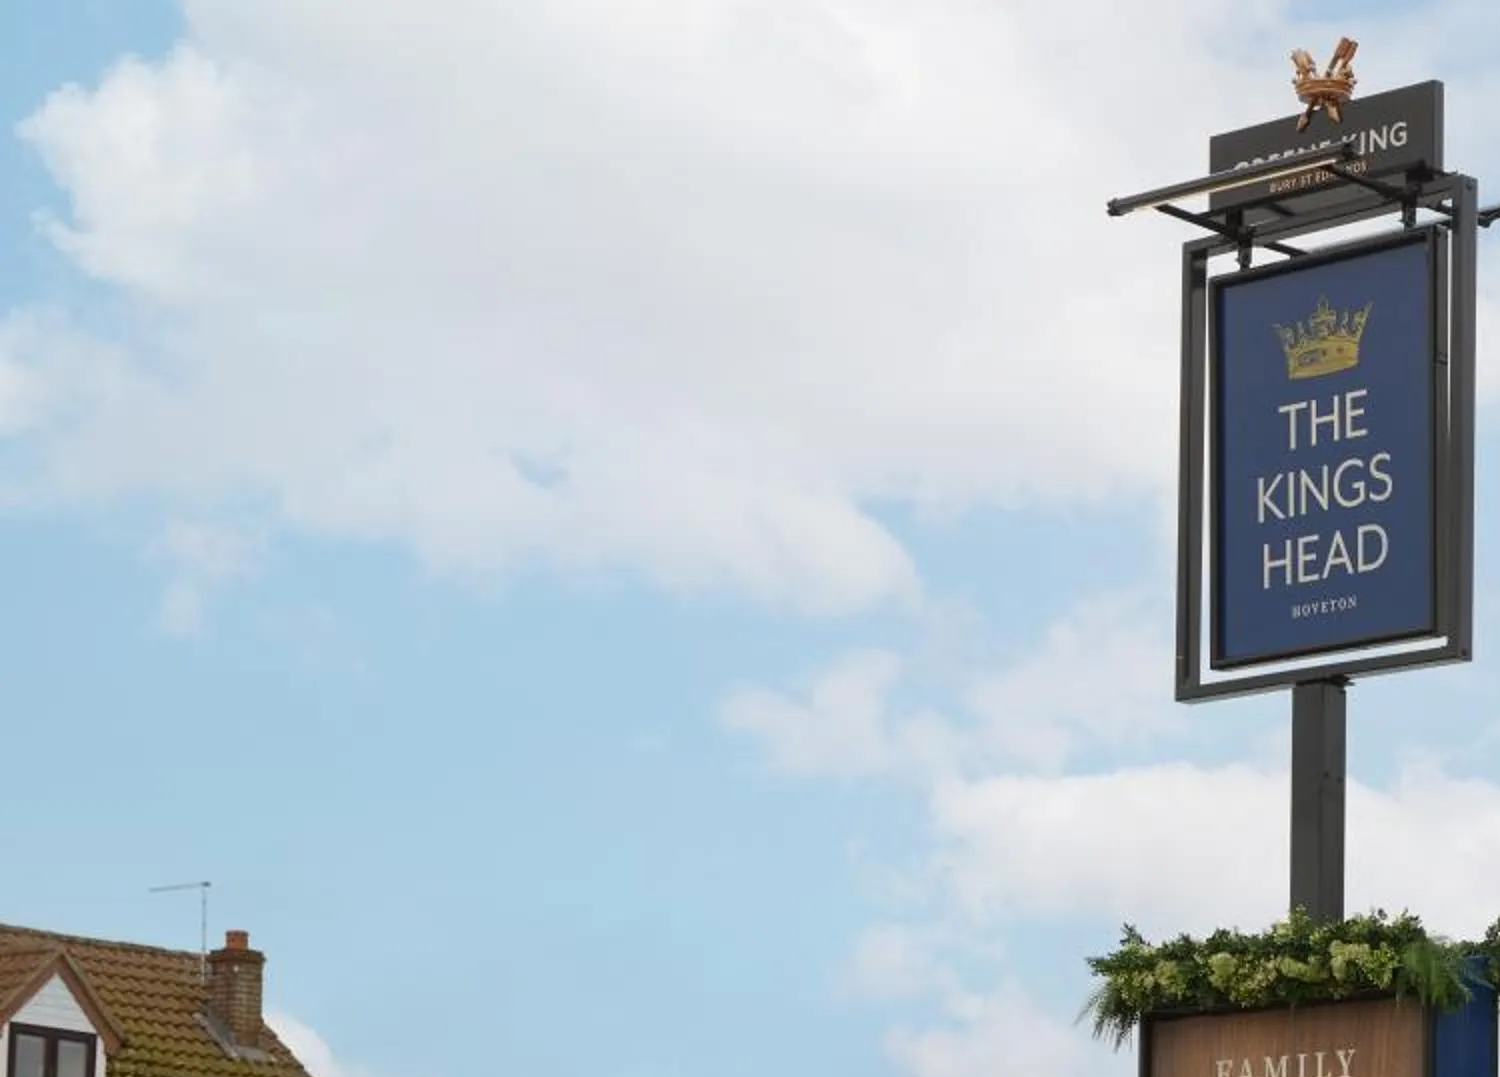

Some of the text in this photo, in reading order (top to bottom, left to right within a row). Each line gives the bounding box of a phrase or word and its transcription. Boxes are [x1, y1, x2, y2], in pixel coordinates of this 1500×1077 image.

[1278, 388, 1368, 450] THE
[1257, 450, 1393, 524] KINGS
[1263, 523, 1389, 589] HEAD
[1291, 594, 1358, 619] HOVETON
